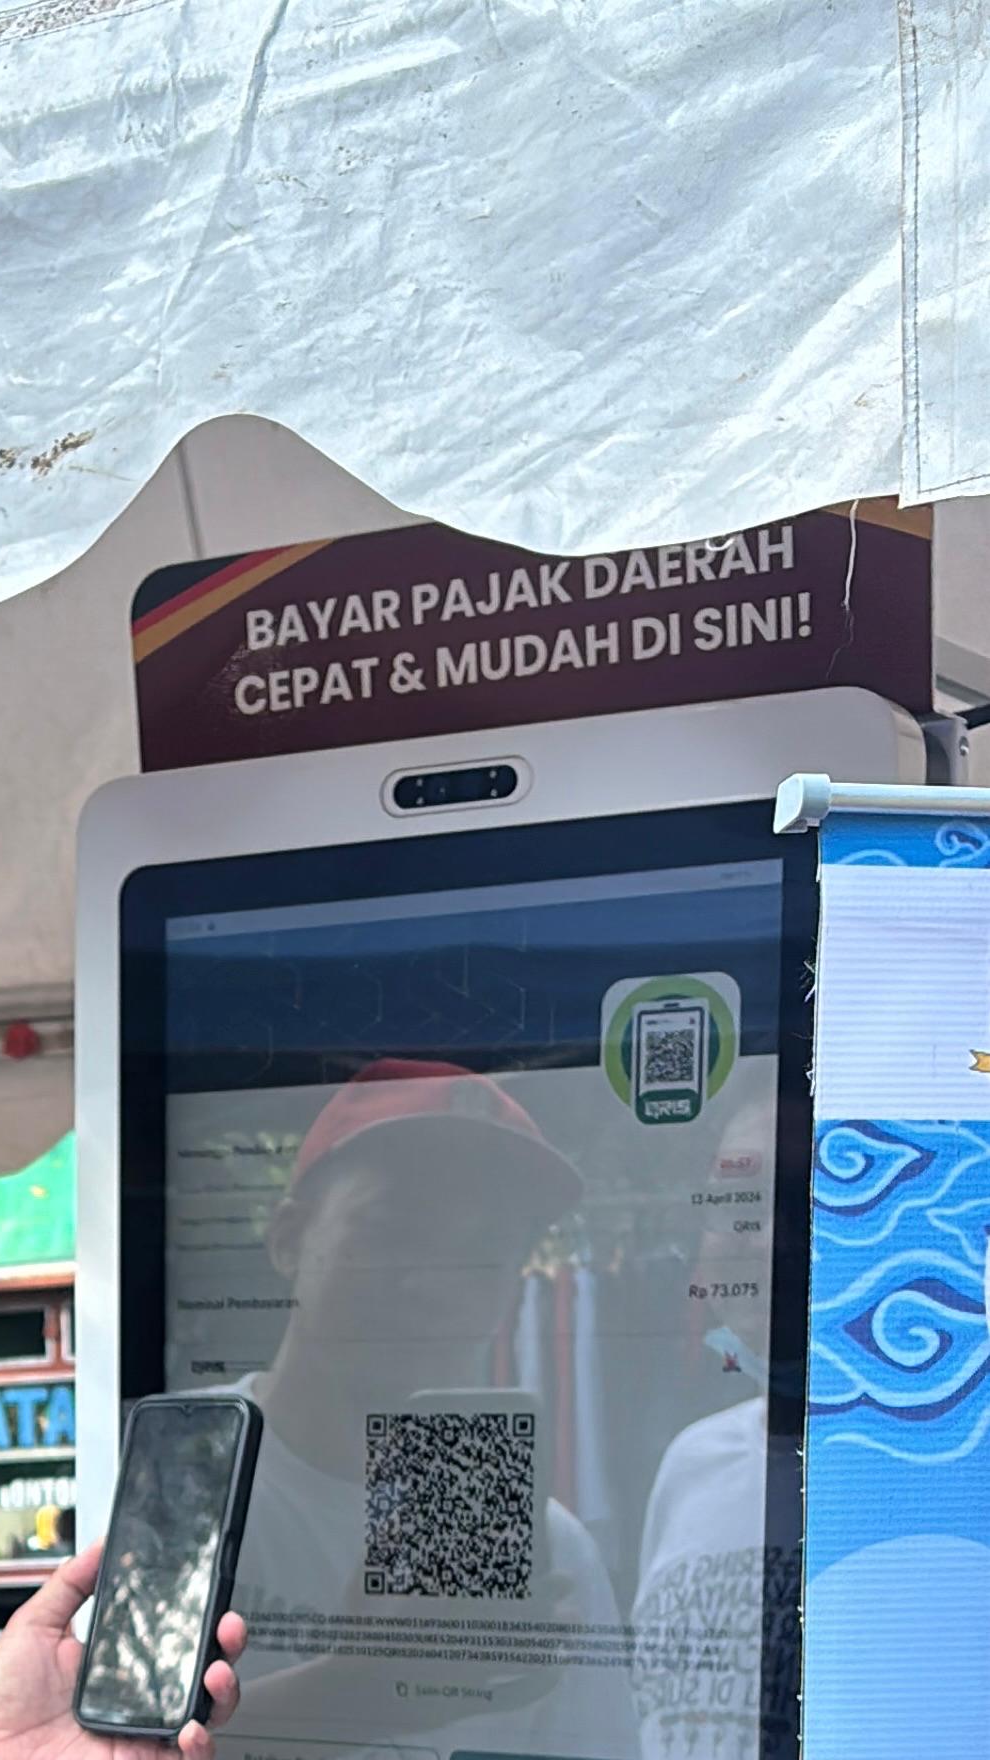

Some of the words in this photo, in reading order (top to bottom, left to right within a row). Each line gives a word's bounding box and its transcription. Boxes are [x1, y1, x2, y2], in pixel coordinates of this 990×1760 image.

[245, 588, 401, 651] BAYAR
[411, 561, 573, 626] PAJAK
[583, 524, 795, 600] DAERAH
[233, 656, 380, 716] CEPAT
[388, 651, 427, 695] &
[435, 621, 620, 688] MUDAH
[631, 612, 681, 661] DI
[692, 591, 812, 652] SINI!
[706, 1192, 732, 1206] April
[688, 1285, 707, 1299] Rp
[710, 1282, 759, 1298] 73.075
